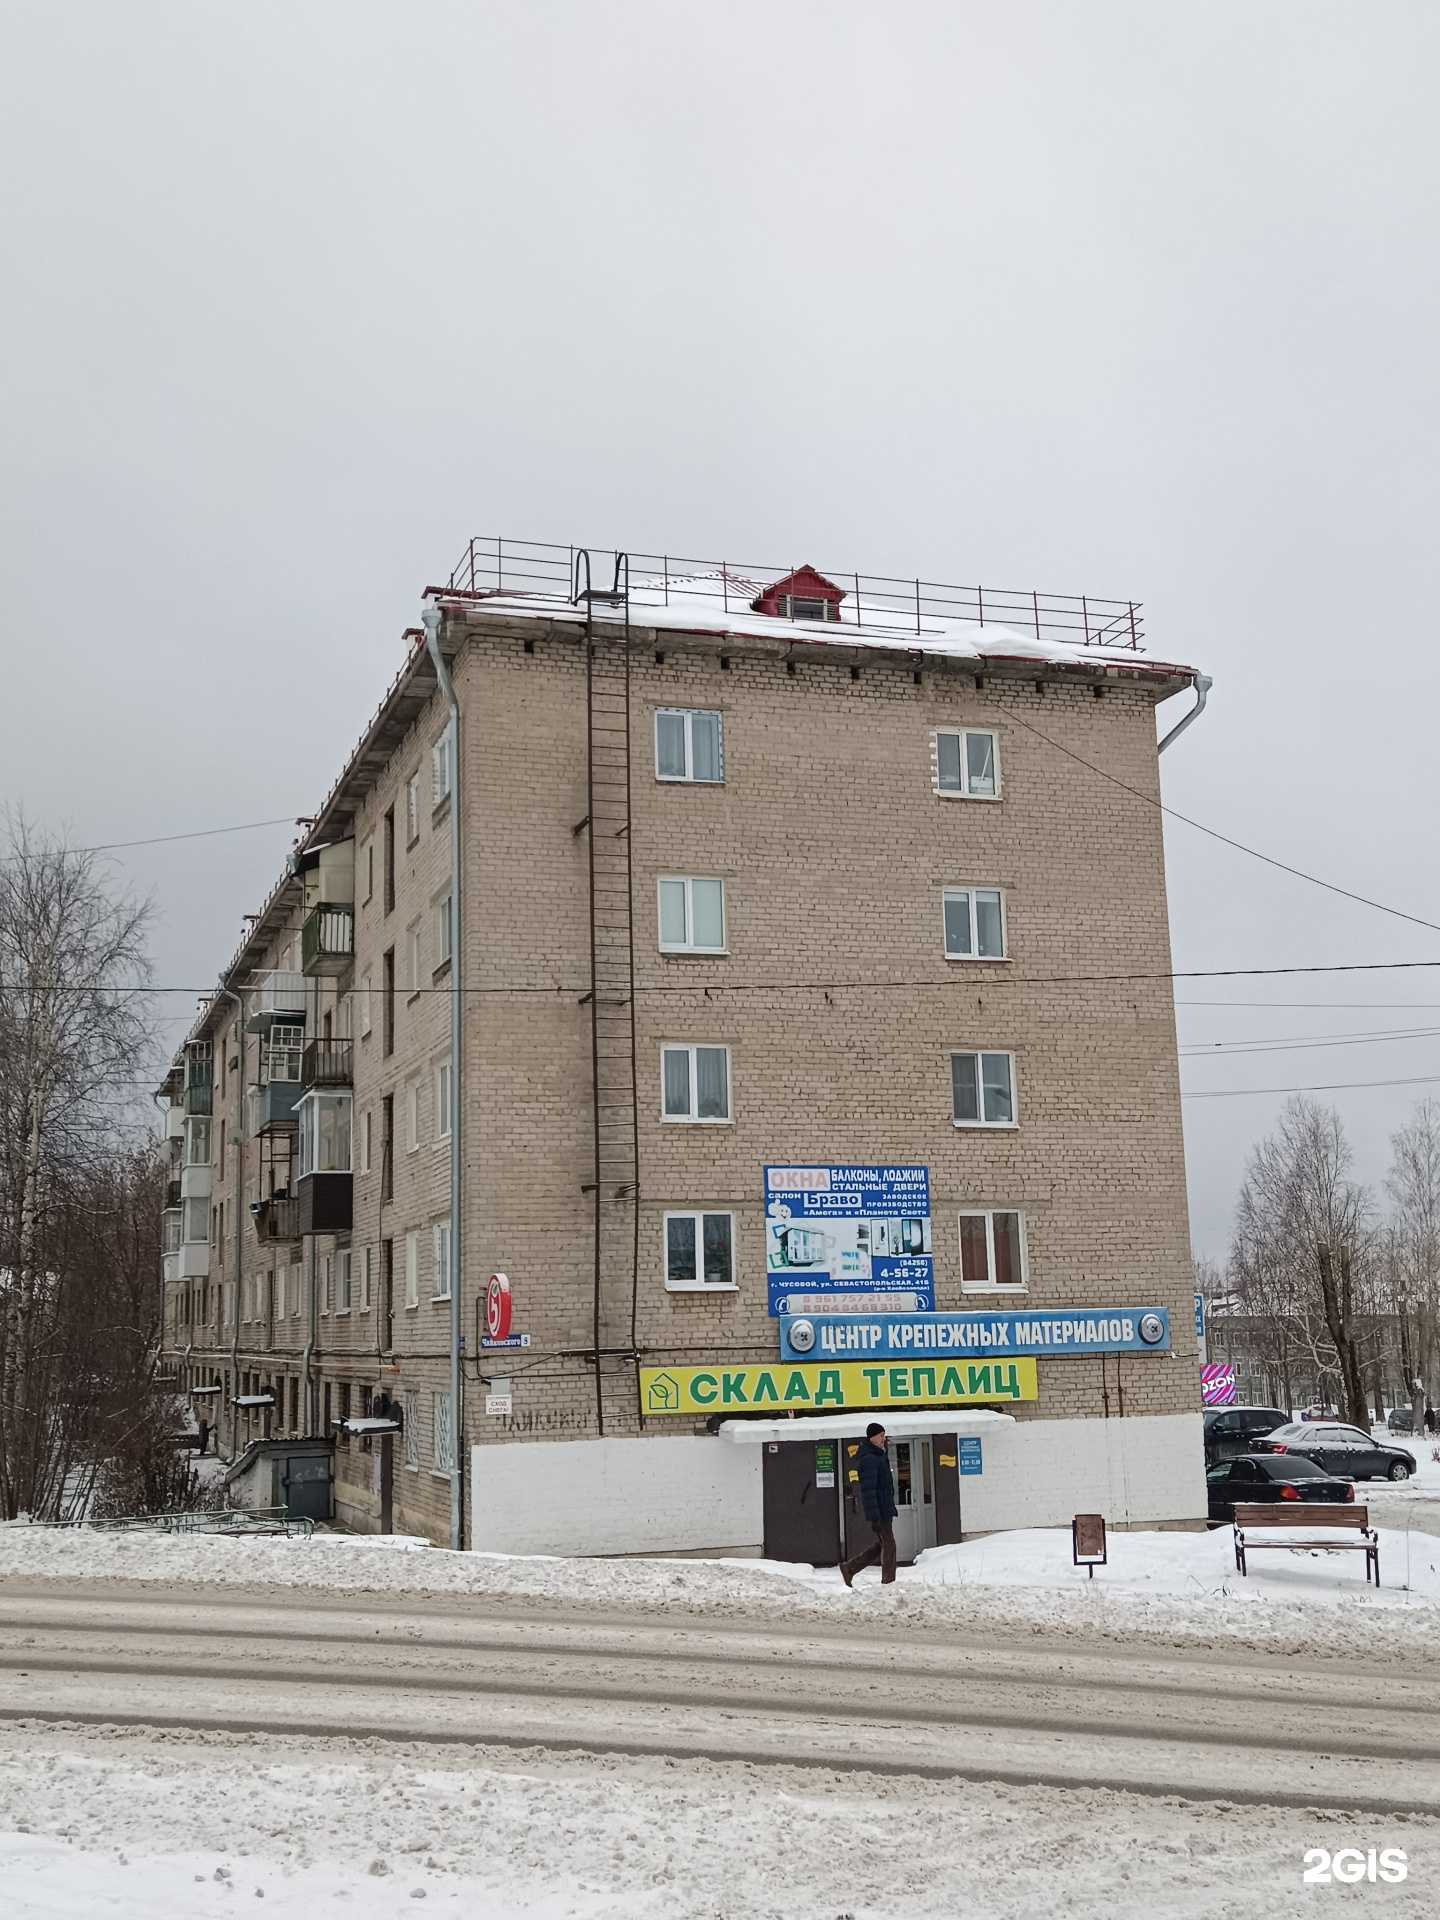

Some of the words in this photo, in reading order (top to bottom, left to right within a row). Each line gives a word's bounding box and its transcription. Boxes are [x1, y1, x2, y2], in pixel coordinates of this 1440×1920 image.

[770, 1172, 827, 1188] ОКНА
[831, 1169, 882, 1183] БАЛКОНЫ,
[883, 1169, 925, 1182] ЛОДЖИИ
[832, 1183, 888, 1191] СТАЛЬНЫЕ
[893, 1183, 927, 1192] ДВЕРИ
[807, 1192, 859, 1208] Браво
[880, 1267, 928, 1278] 4-56-27
[779, 1280, 819, 1288] ЧУСОВОЙ,
[833, 1279, 914, 1288] СЕВАСТОПОЛЬСКАЯ,
[821, 1325, 882, 1353] ЦЕНТР
[888, 1322, 1009, 1349] КРЕПЕЖНЫХ
[1014, 1318, 1134, 1345] МАТЕРИАЛОВ
[690, 1370, 844, 1406] СКЛАД
[863, 1364, 1020, 1399] ТЕПЛИЦ
